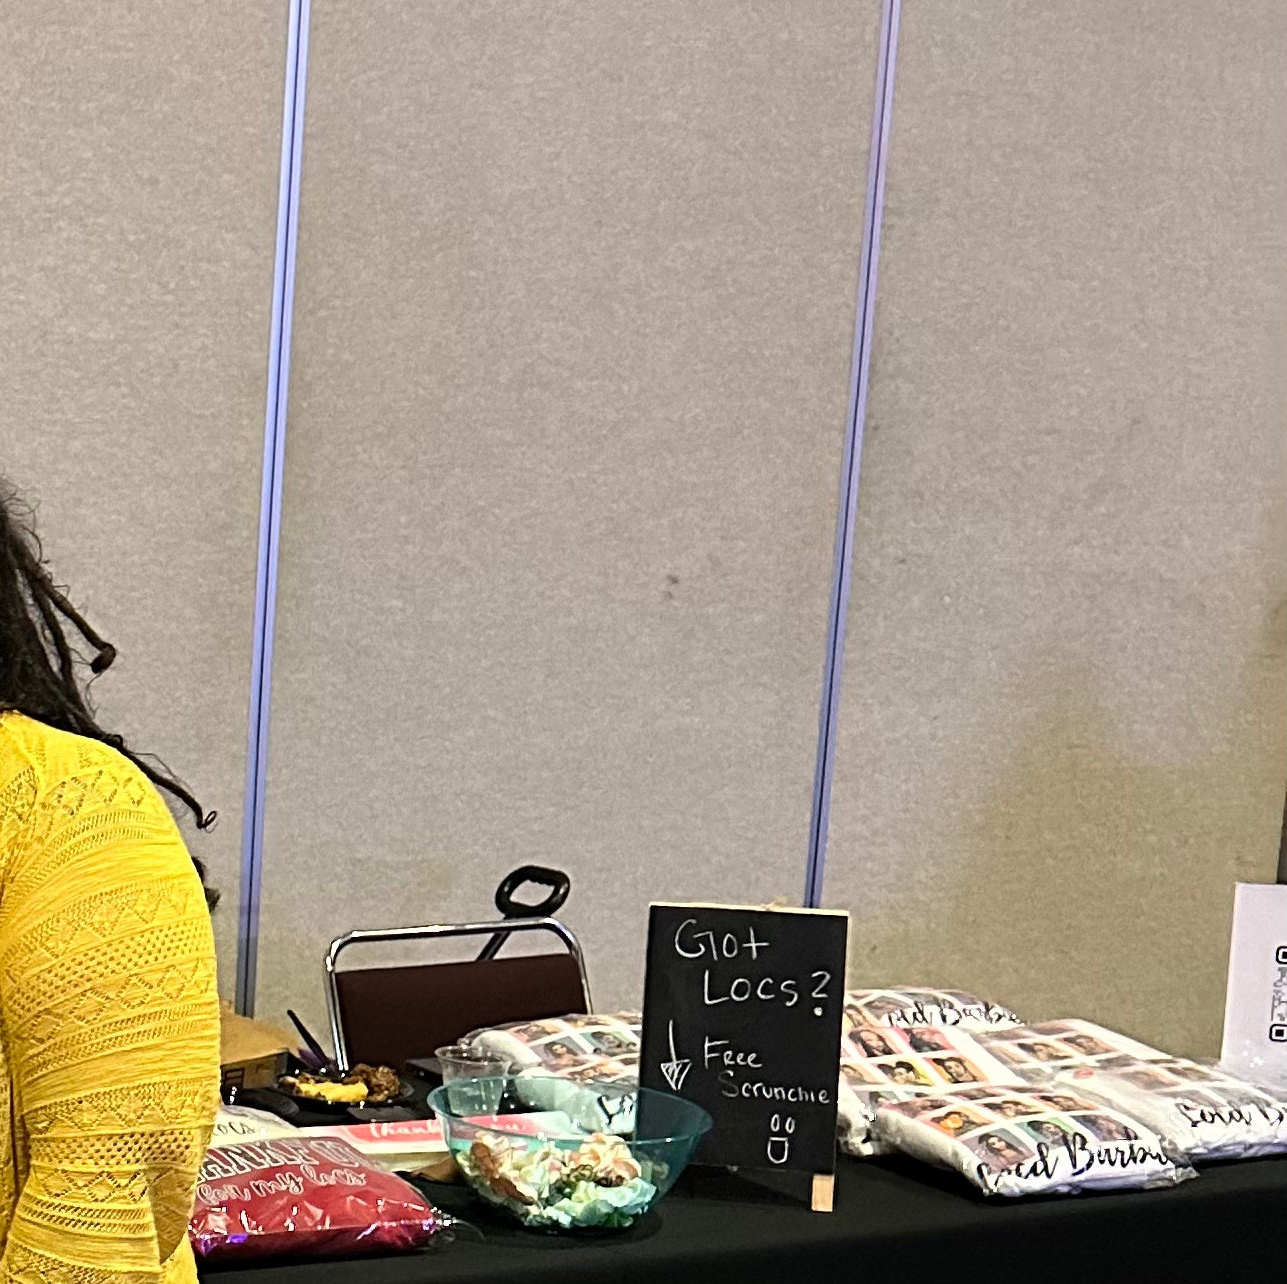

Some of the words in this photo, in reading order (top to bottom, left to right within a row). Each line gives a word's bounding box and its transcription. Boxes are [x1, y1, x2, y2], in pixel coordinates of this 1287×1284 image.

[674, 918, 770, 961] Got
[717, 1070, 831, 1105] Scrunchie
[252, 1171, 305, 1196] my
